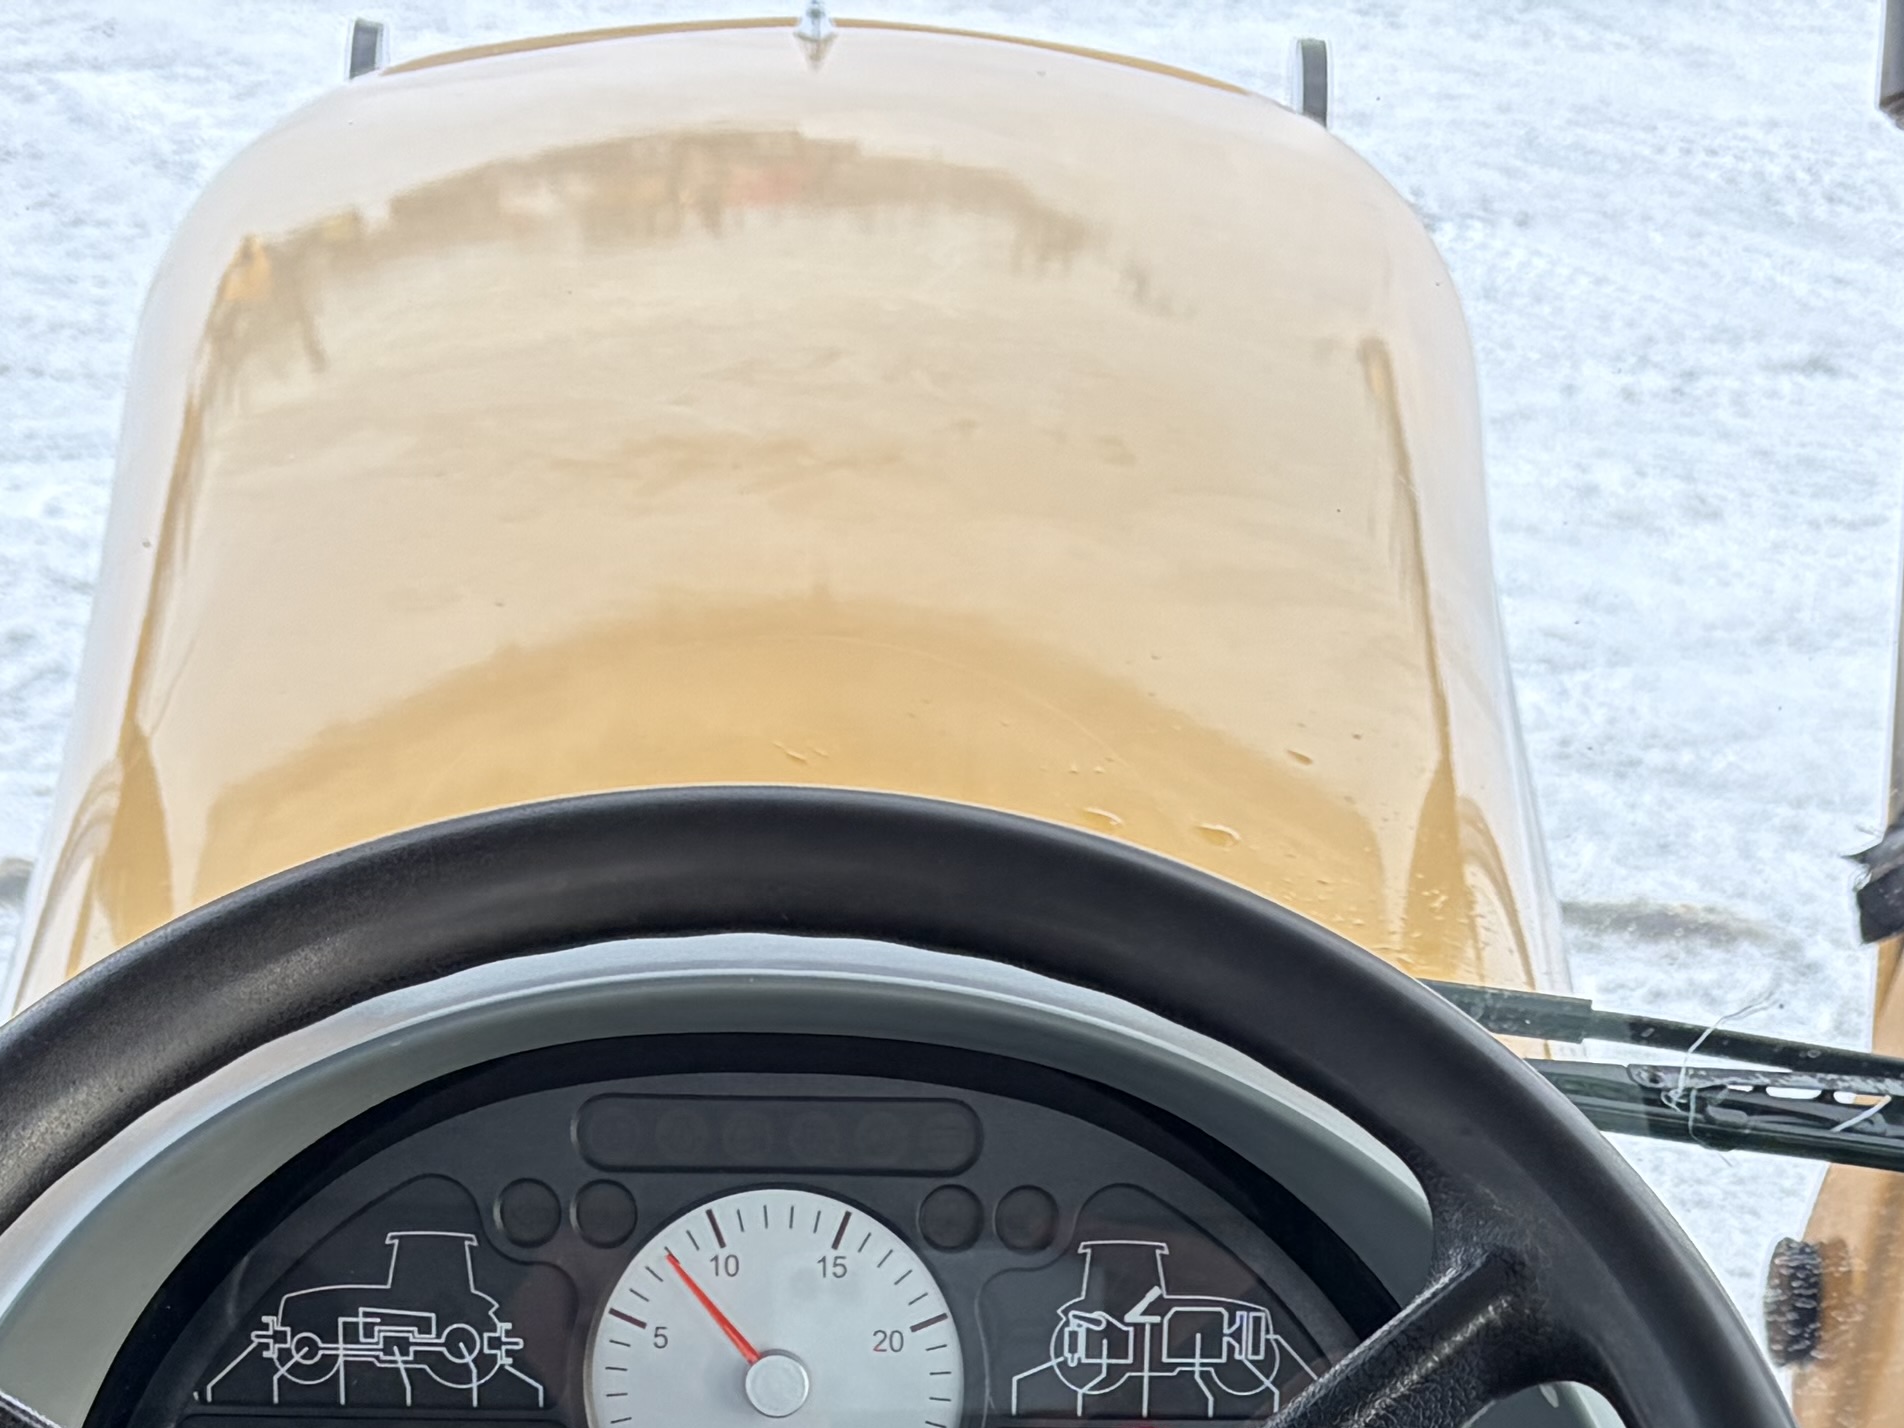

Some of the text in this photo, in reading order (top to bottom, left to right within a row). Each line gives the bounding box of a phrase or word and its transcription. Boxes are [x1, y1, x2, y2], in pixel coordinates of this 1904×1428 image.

[709, 1255, 740, 1277] 10
[817, 1256, 847, 1278] 15
[652, 1326, 669, 1349] 5
[872, 1329, 904, 1353] 20
